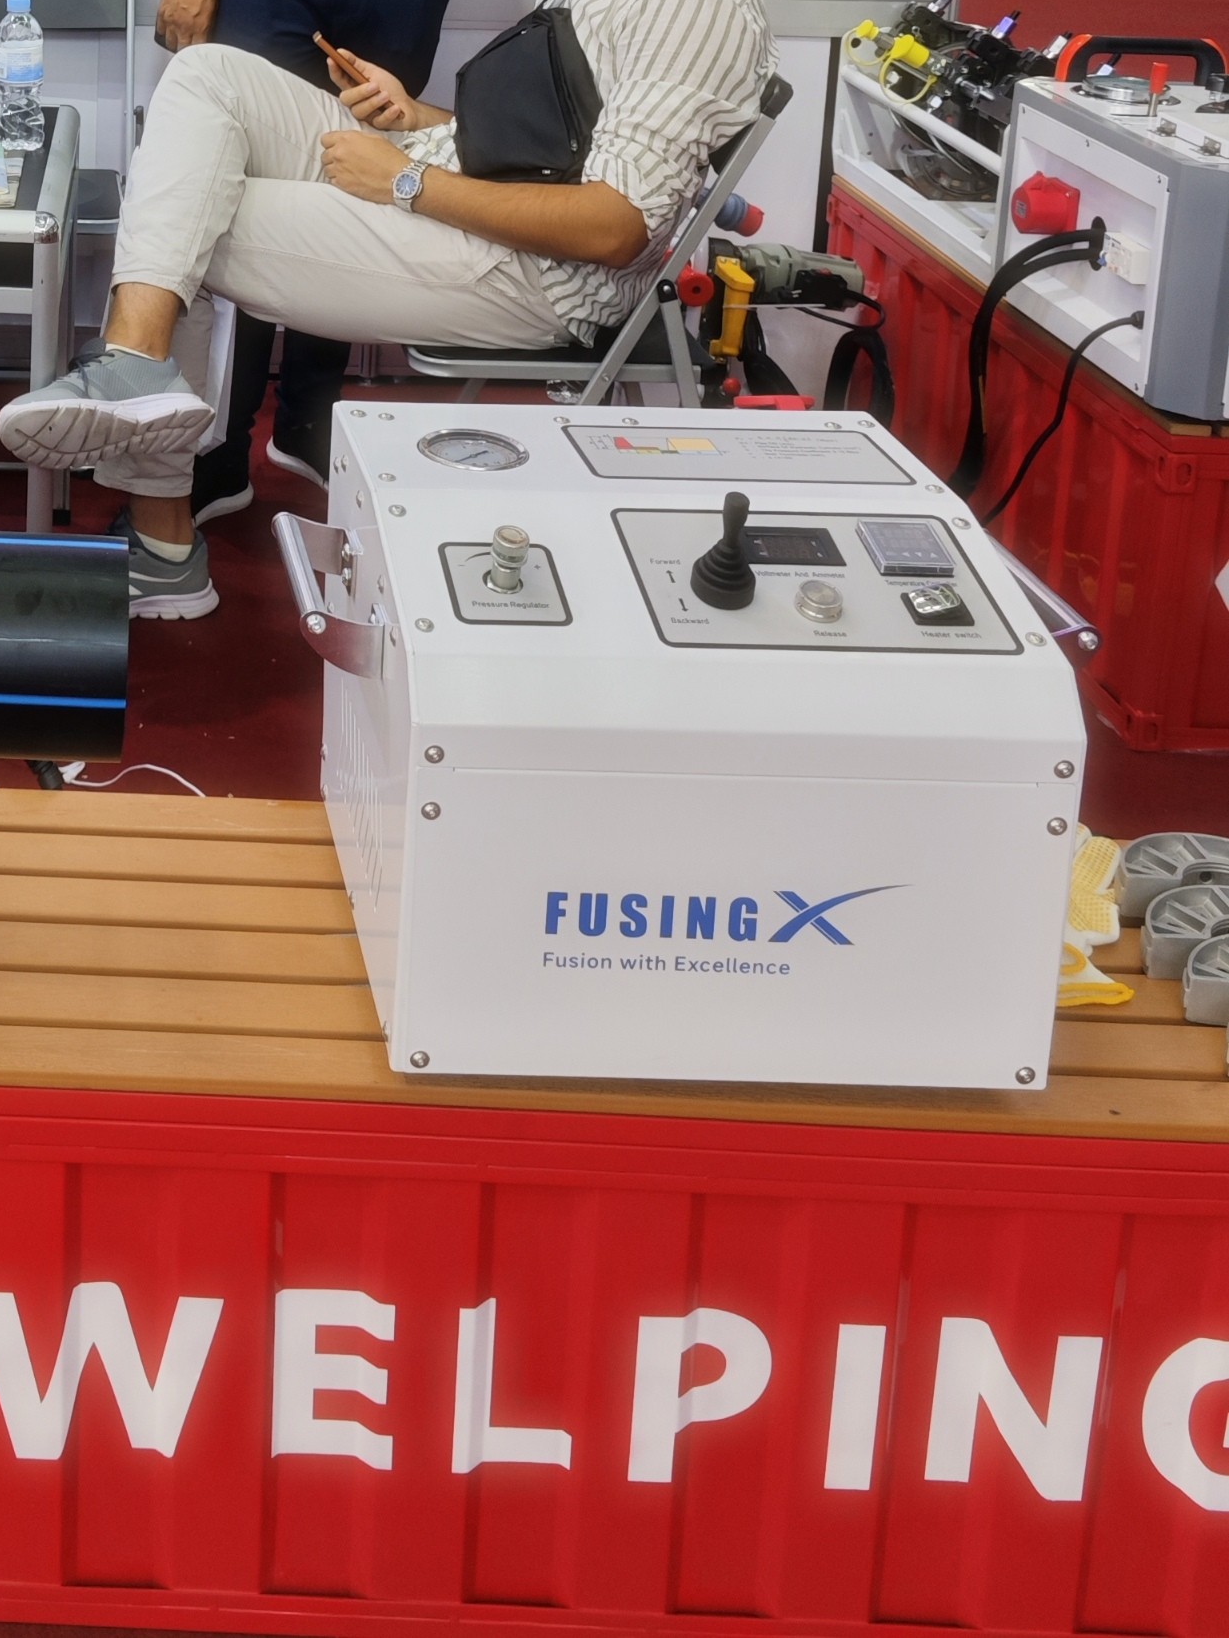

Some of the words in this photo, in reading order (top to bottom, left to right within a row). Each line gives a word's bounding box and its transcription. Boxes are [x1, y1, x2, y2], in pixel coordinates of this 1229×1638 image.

[510, 602, 550, 610] Regulator
[671, 617, 710, 625] Backward
[814, 630, 847, 638] Release
[545, 884, 915, 946] FUSINGX
[542, 951, 613, 970] Fusion
[620, 953, 667, 972] with
[674, 955, 791, 975] Excellence
